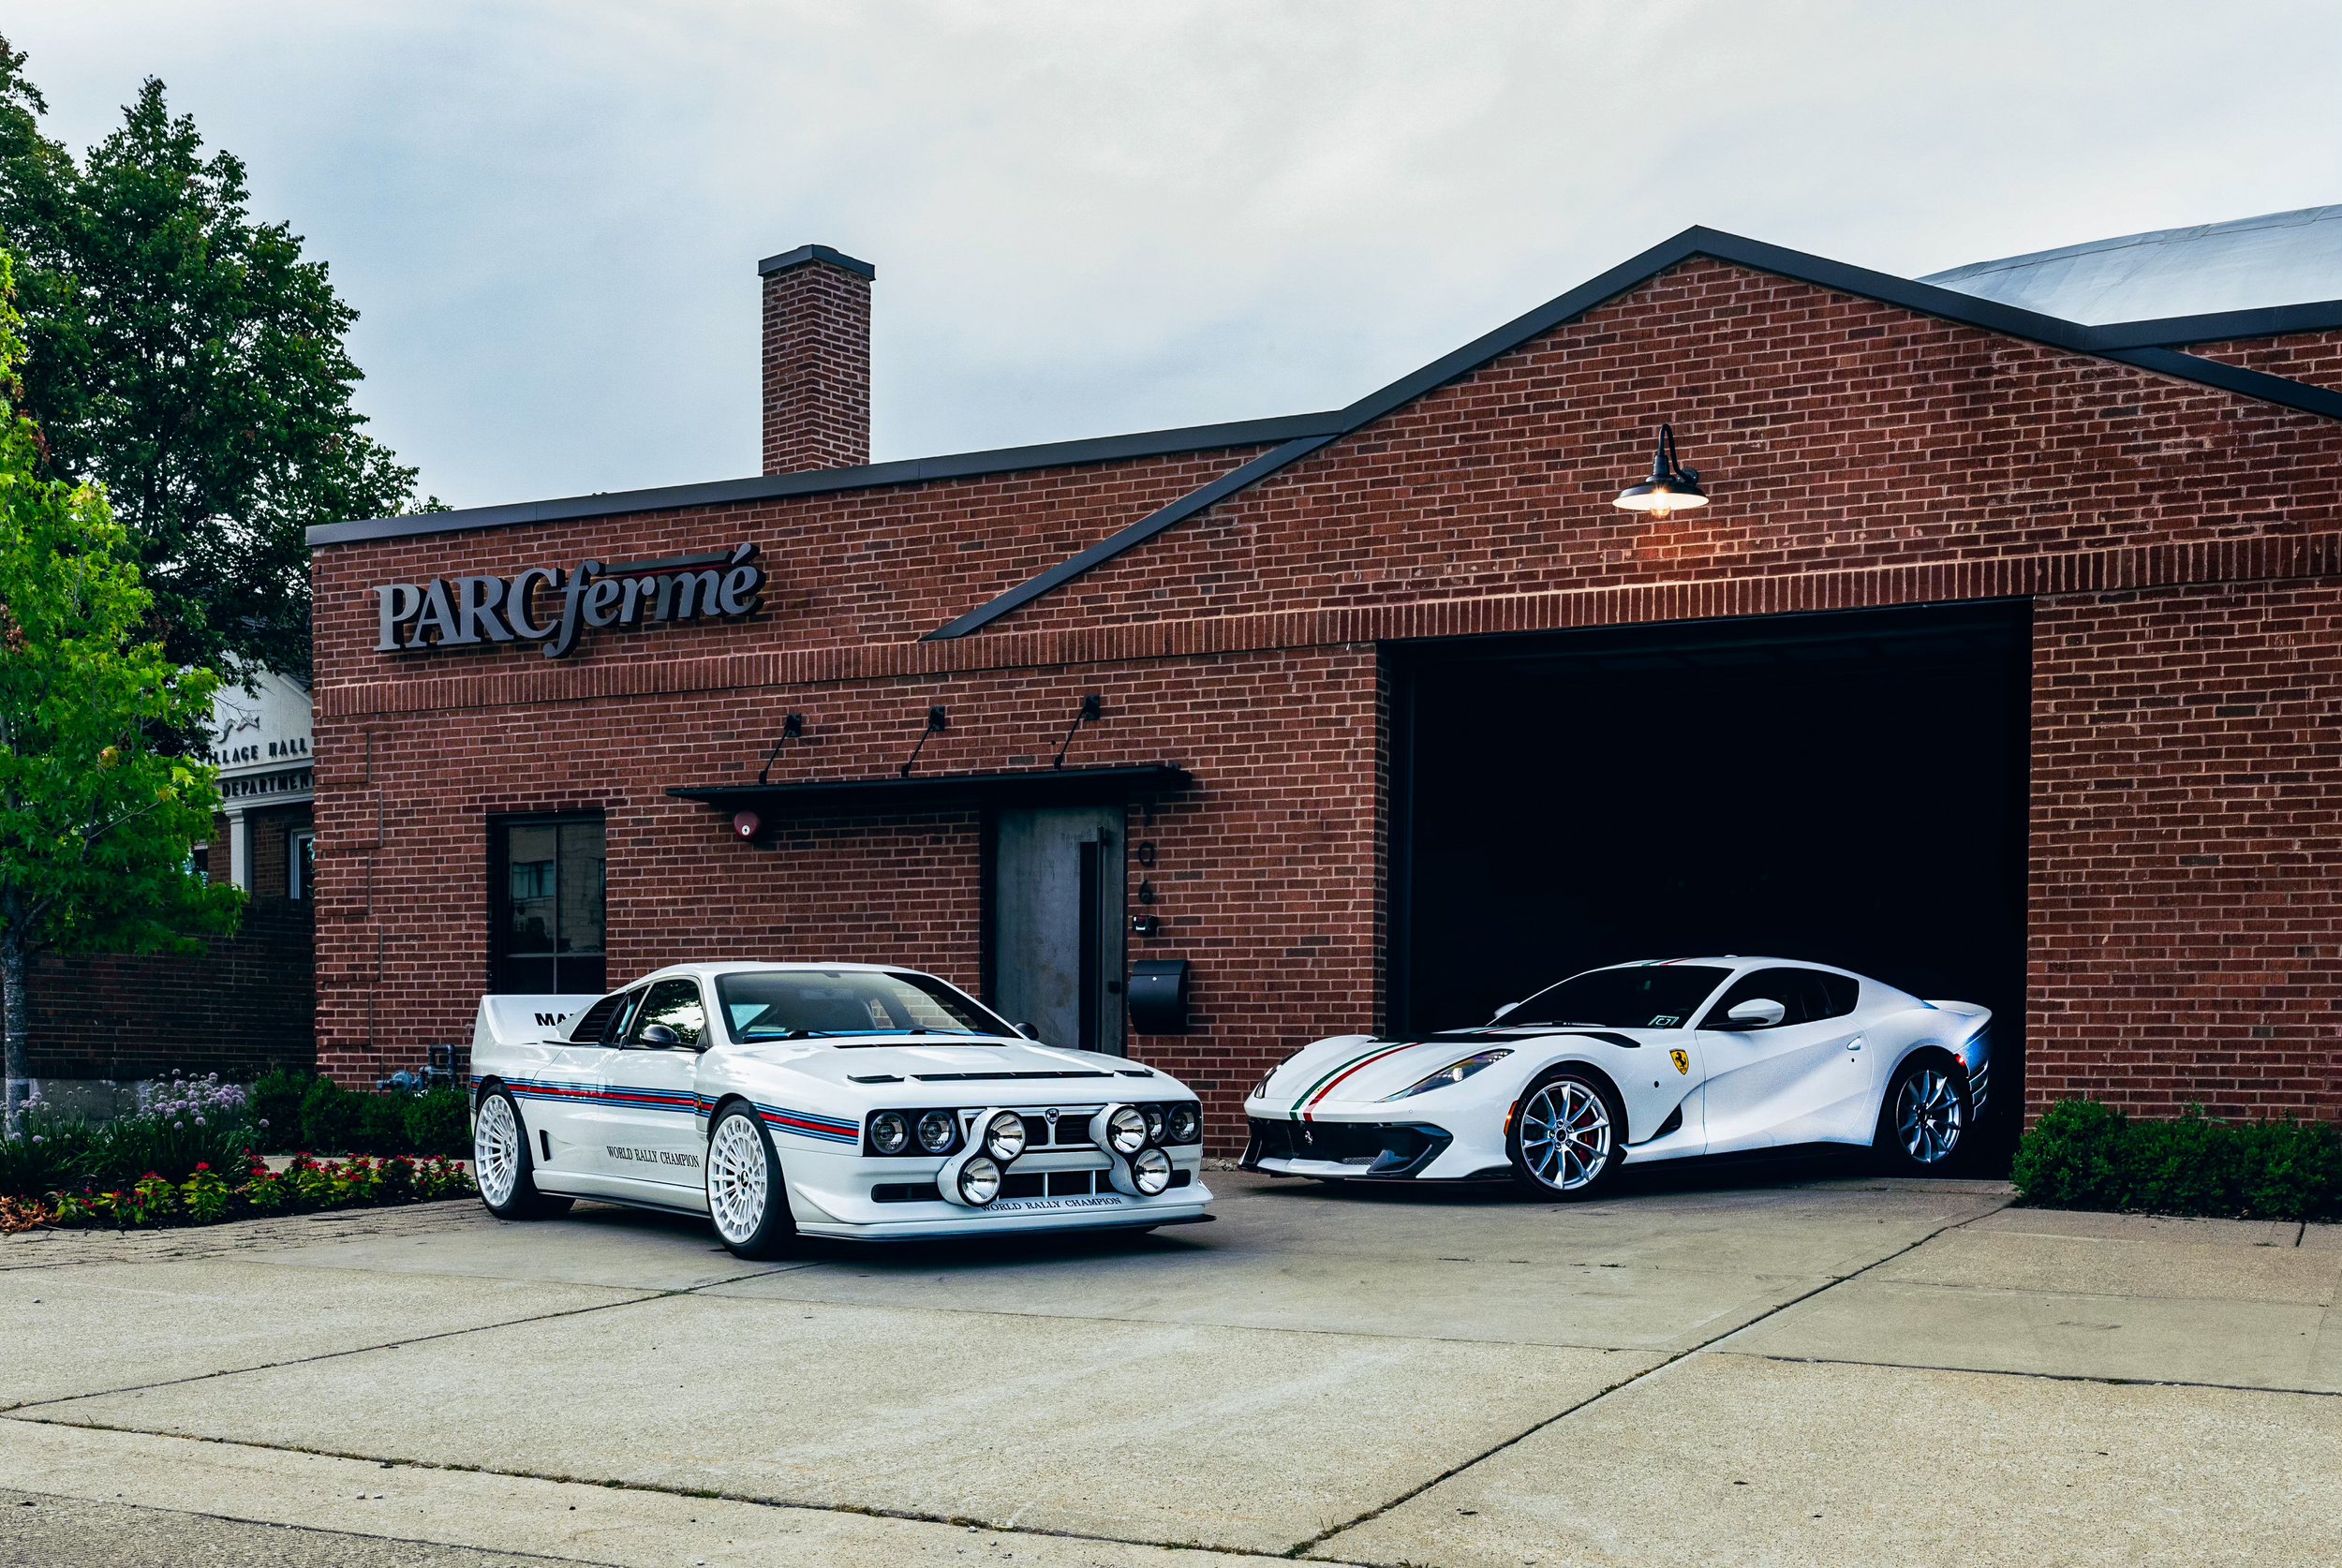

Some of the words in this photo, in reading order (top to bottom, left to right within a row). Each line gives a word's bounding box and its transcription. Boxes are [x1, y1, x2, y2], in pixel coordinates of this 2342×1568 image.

[268, 737, 309, 758] HALL
[222, 772, 315, 798] DEPARTMEN
[534, 1013, 574, 1027] MA
[606, 1146, 633, 1161] WORLD
[634, 1148, 659, 1163] RALLY
[660, 1151, 701, 1168] CHAMPION
[981, 1202, 1022, 1213] WORLD
[1026, 1200, 1061, 1210] RALLY
[1065, 1196, 1123, 1208] CHAMPION
